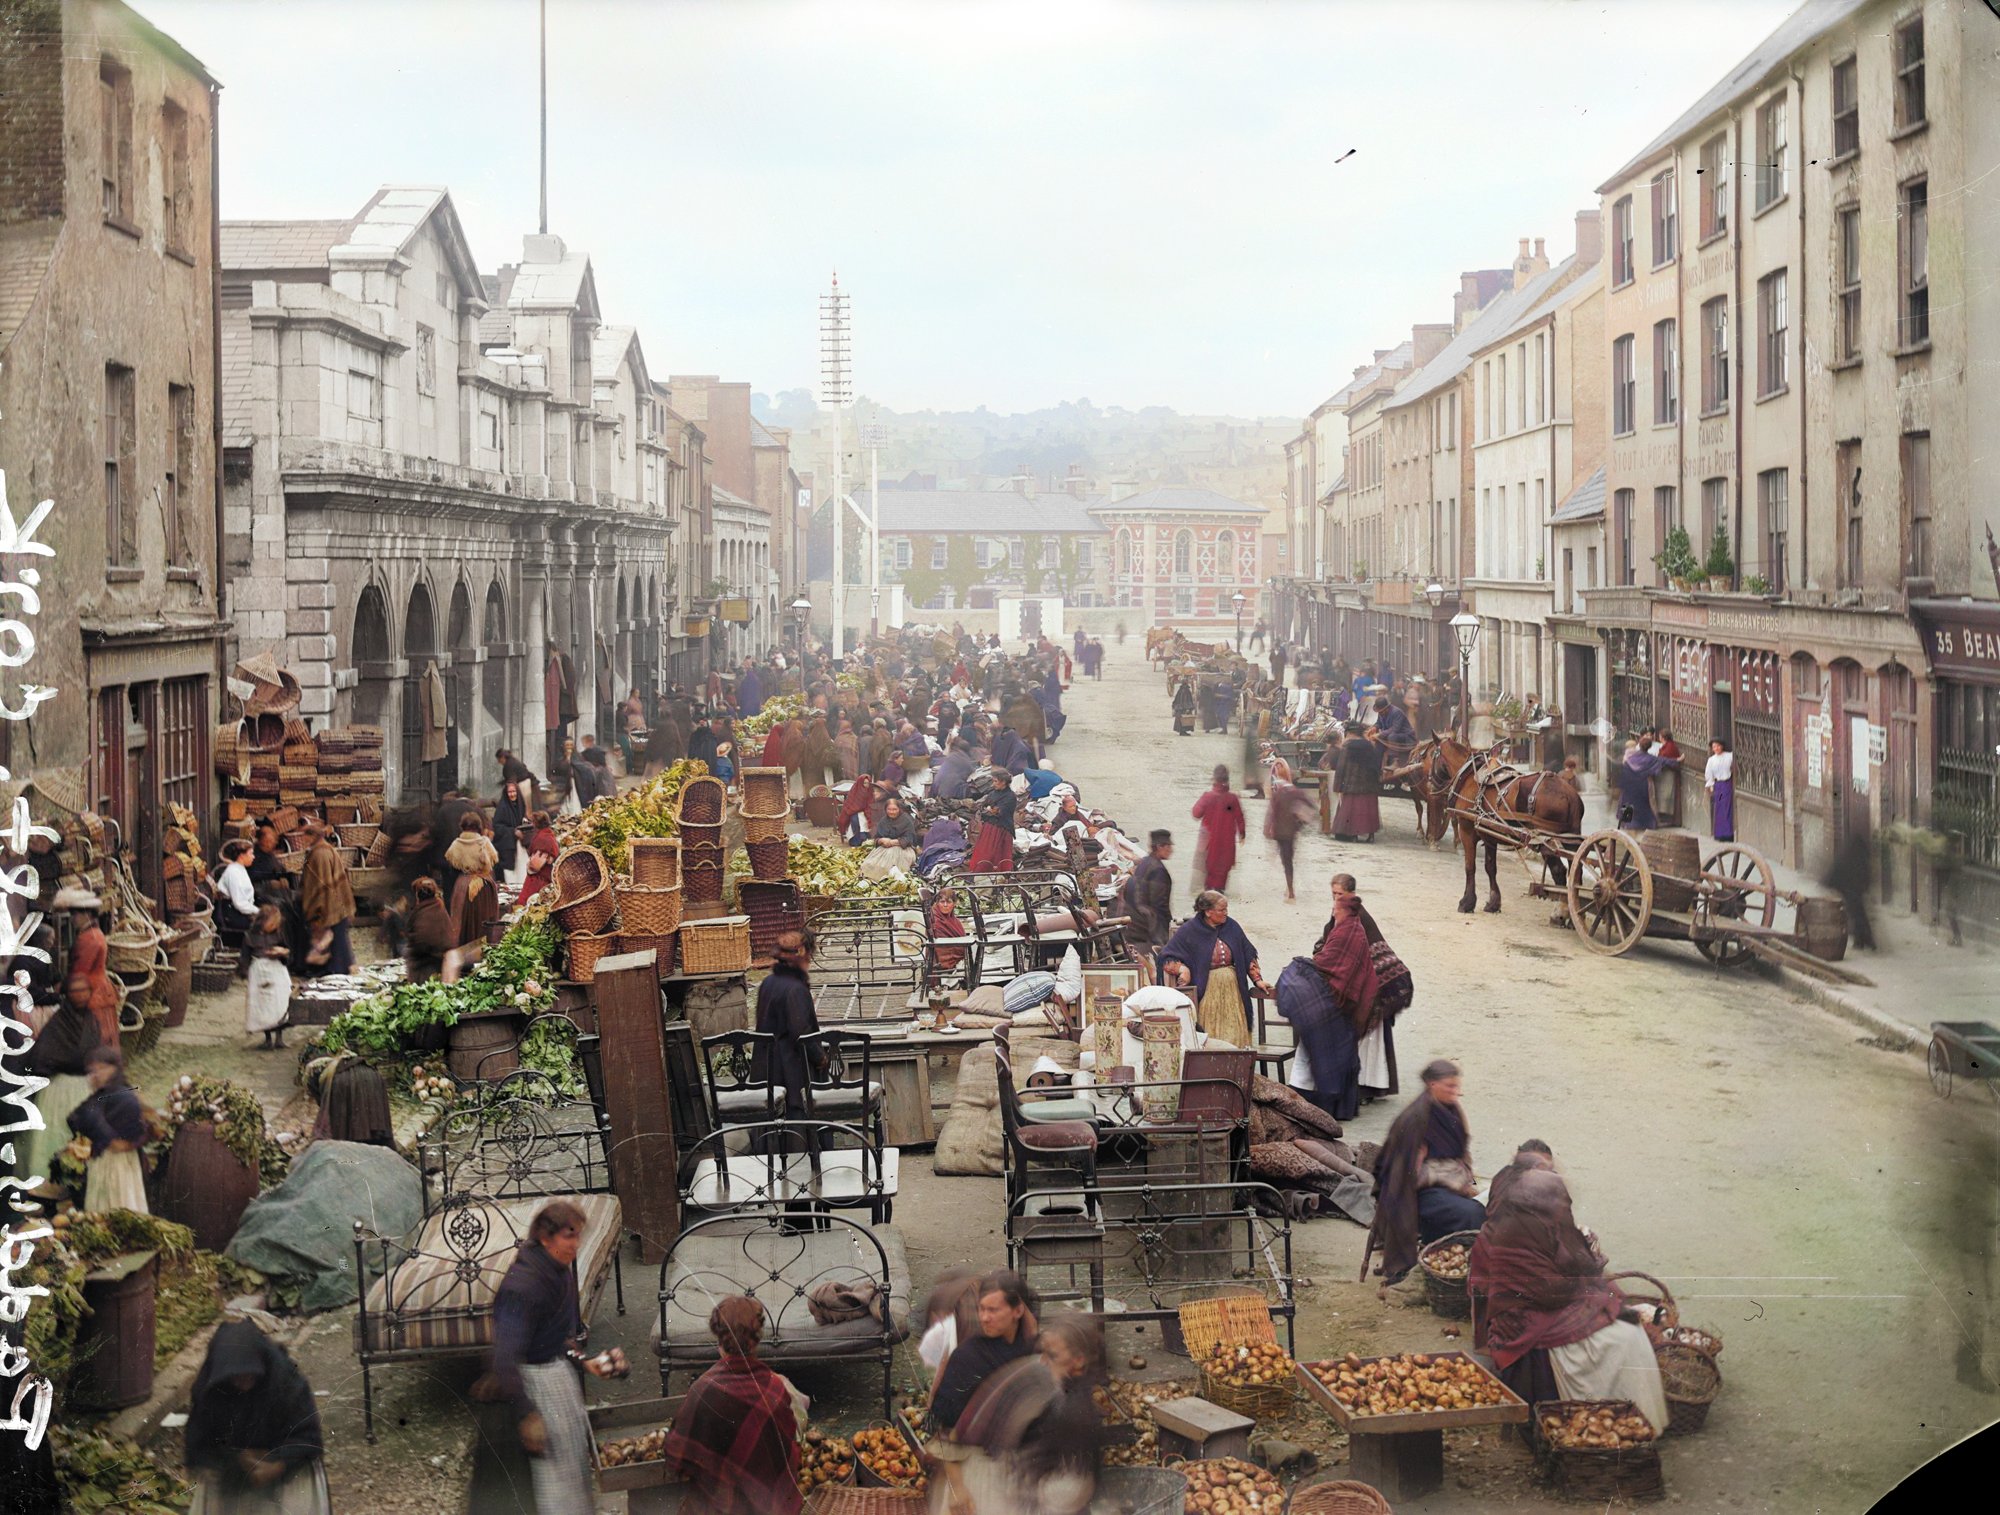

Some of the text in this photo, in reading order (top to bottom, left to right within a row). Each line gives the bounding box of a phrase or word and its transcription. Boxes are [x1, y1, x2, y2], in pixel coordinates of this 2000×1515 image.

[1646, 278, 1676, 308] FAMOUS
[1698, 422, 1724, 448] FAMOUS
[1714, 448, 1736, 474] PORTE
[1935, 625, 2000, 660] 35 BEA
